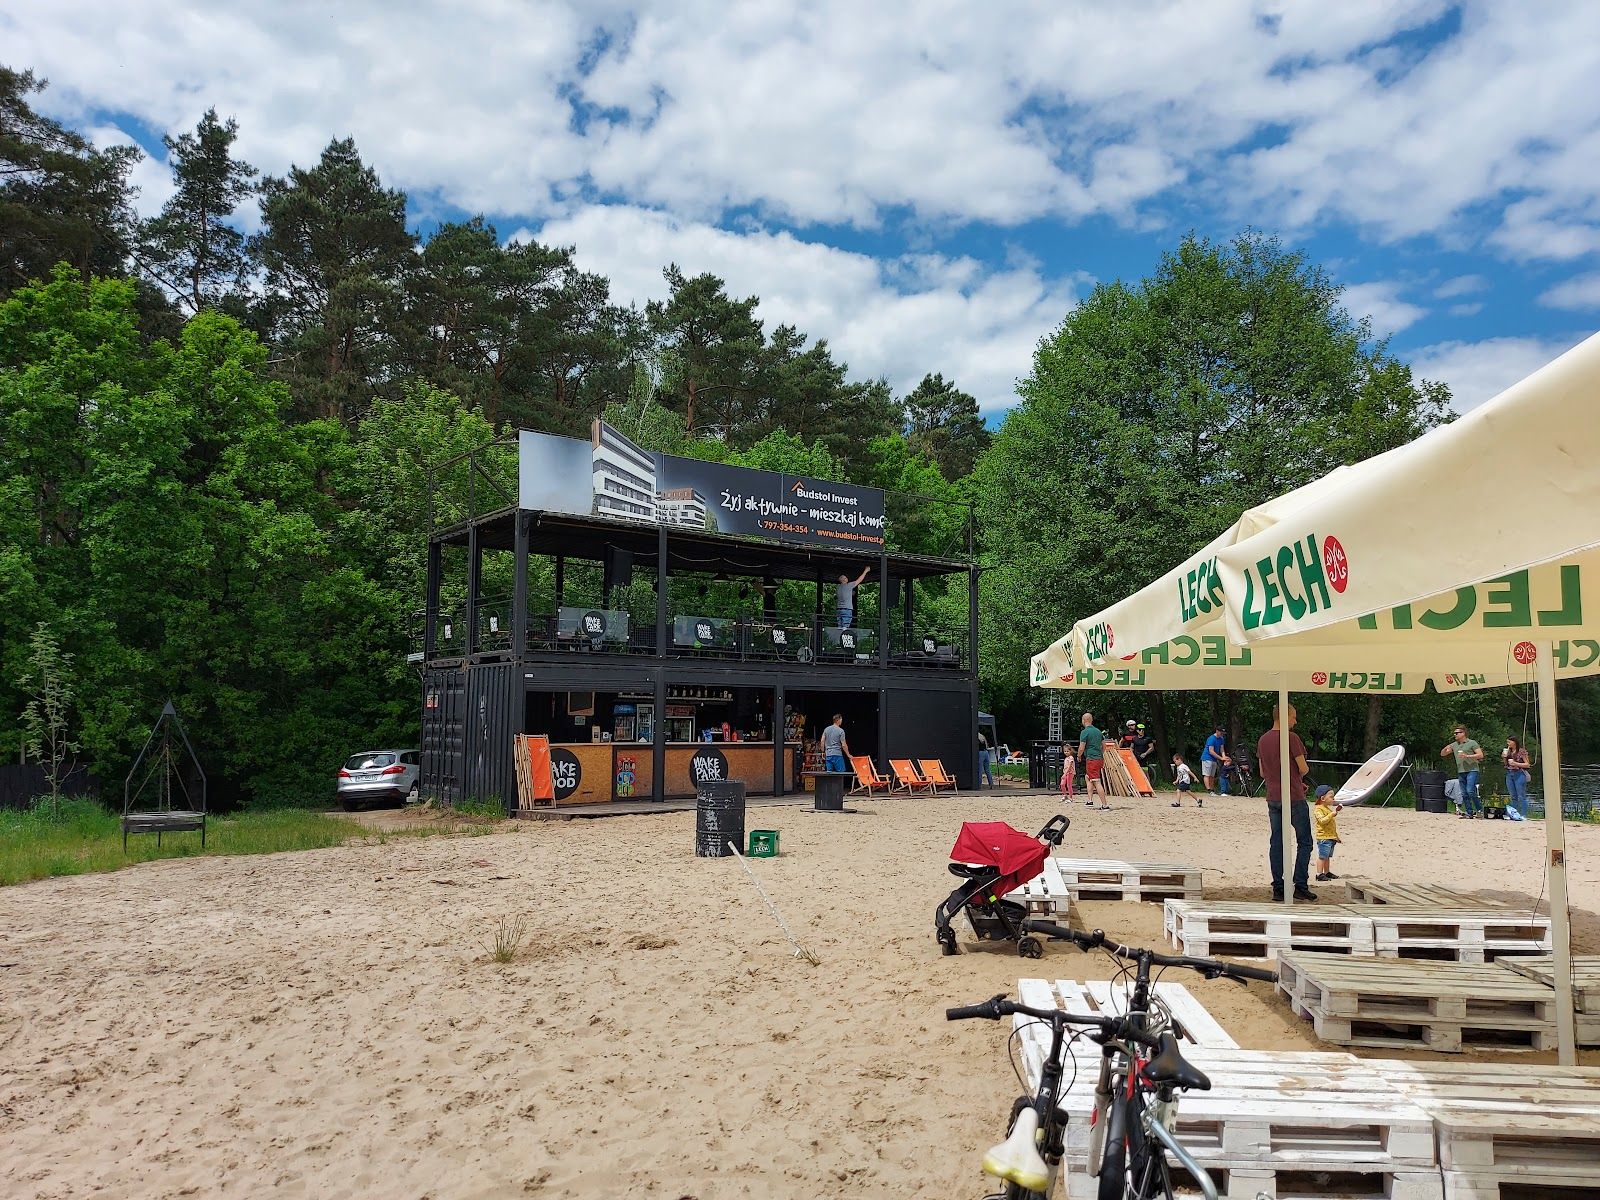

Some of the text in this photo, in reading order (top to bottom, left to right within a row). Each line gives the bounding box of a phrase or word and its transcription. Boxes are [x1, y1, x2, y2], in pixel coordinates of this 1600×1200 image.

[796, 488, 858, 506] Budstol Invest
[720, 488, 742, 512] Żyj
[744, 496, 799, 517] aktywnie
[809, 507, 857, 527] mieszkaj
[763, 520, 809, 535] 797-354-354
[1241, 533, 1332, 631] LECH
[551, 760, 577, 777] AKE
[693, 756, 720, 769] WAKE
[696, 767, 721, 781] PARK
